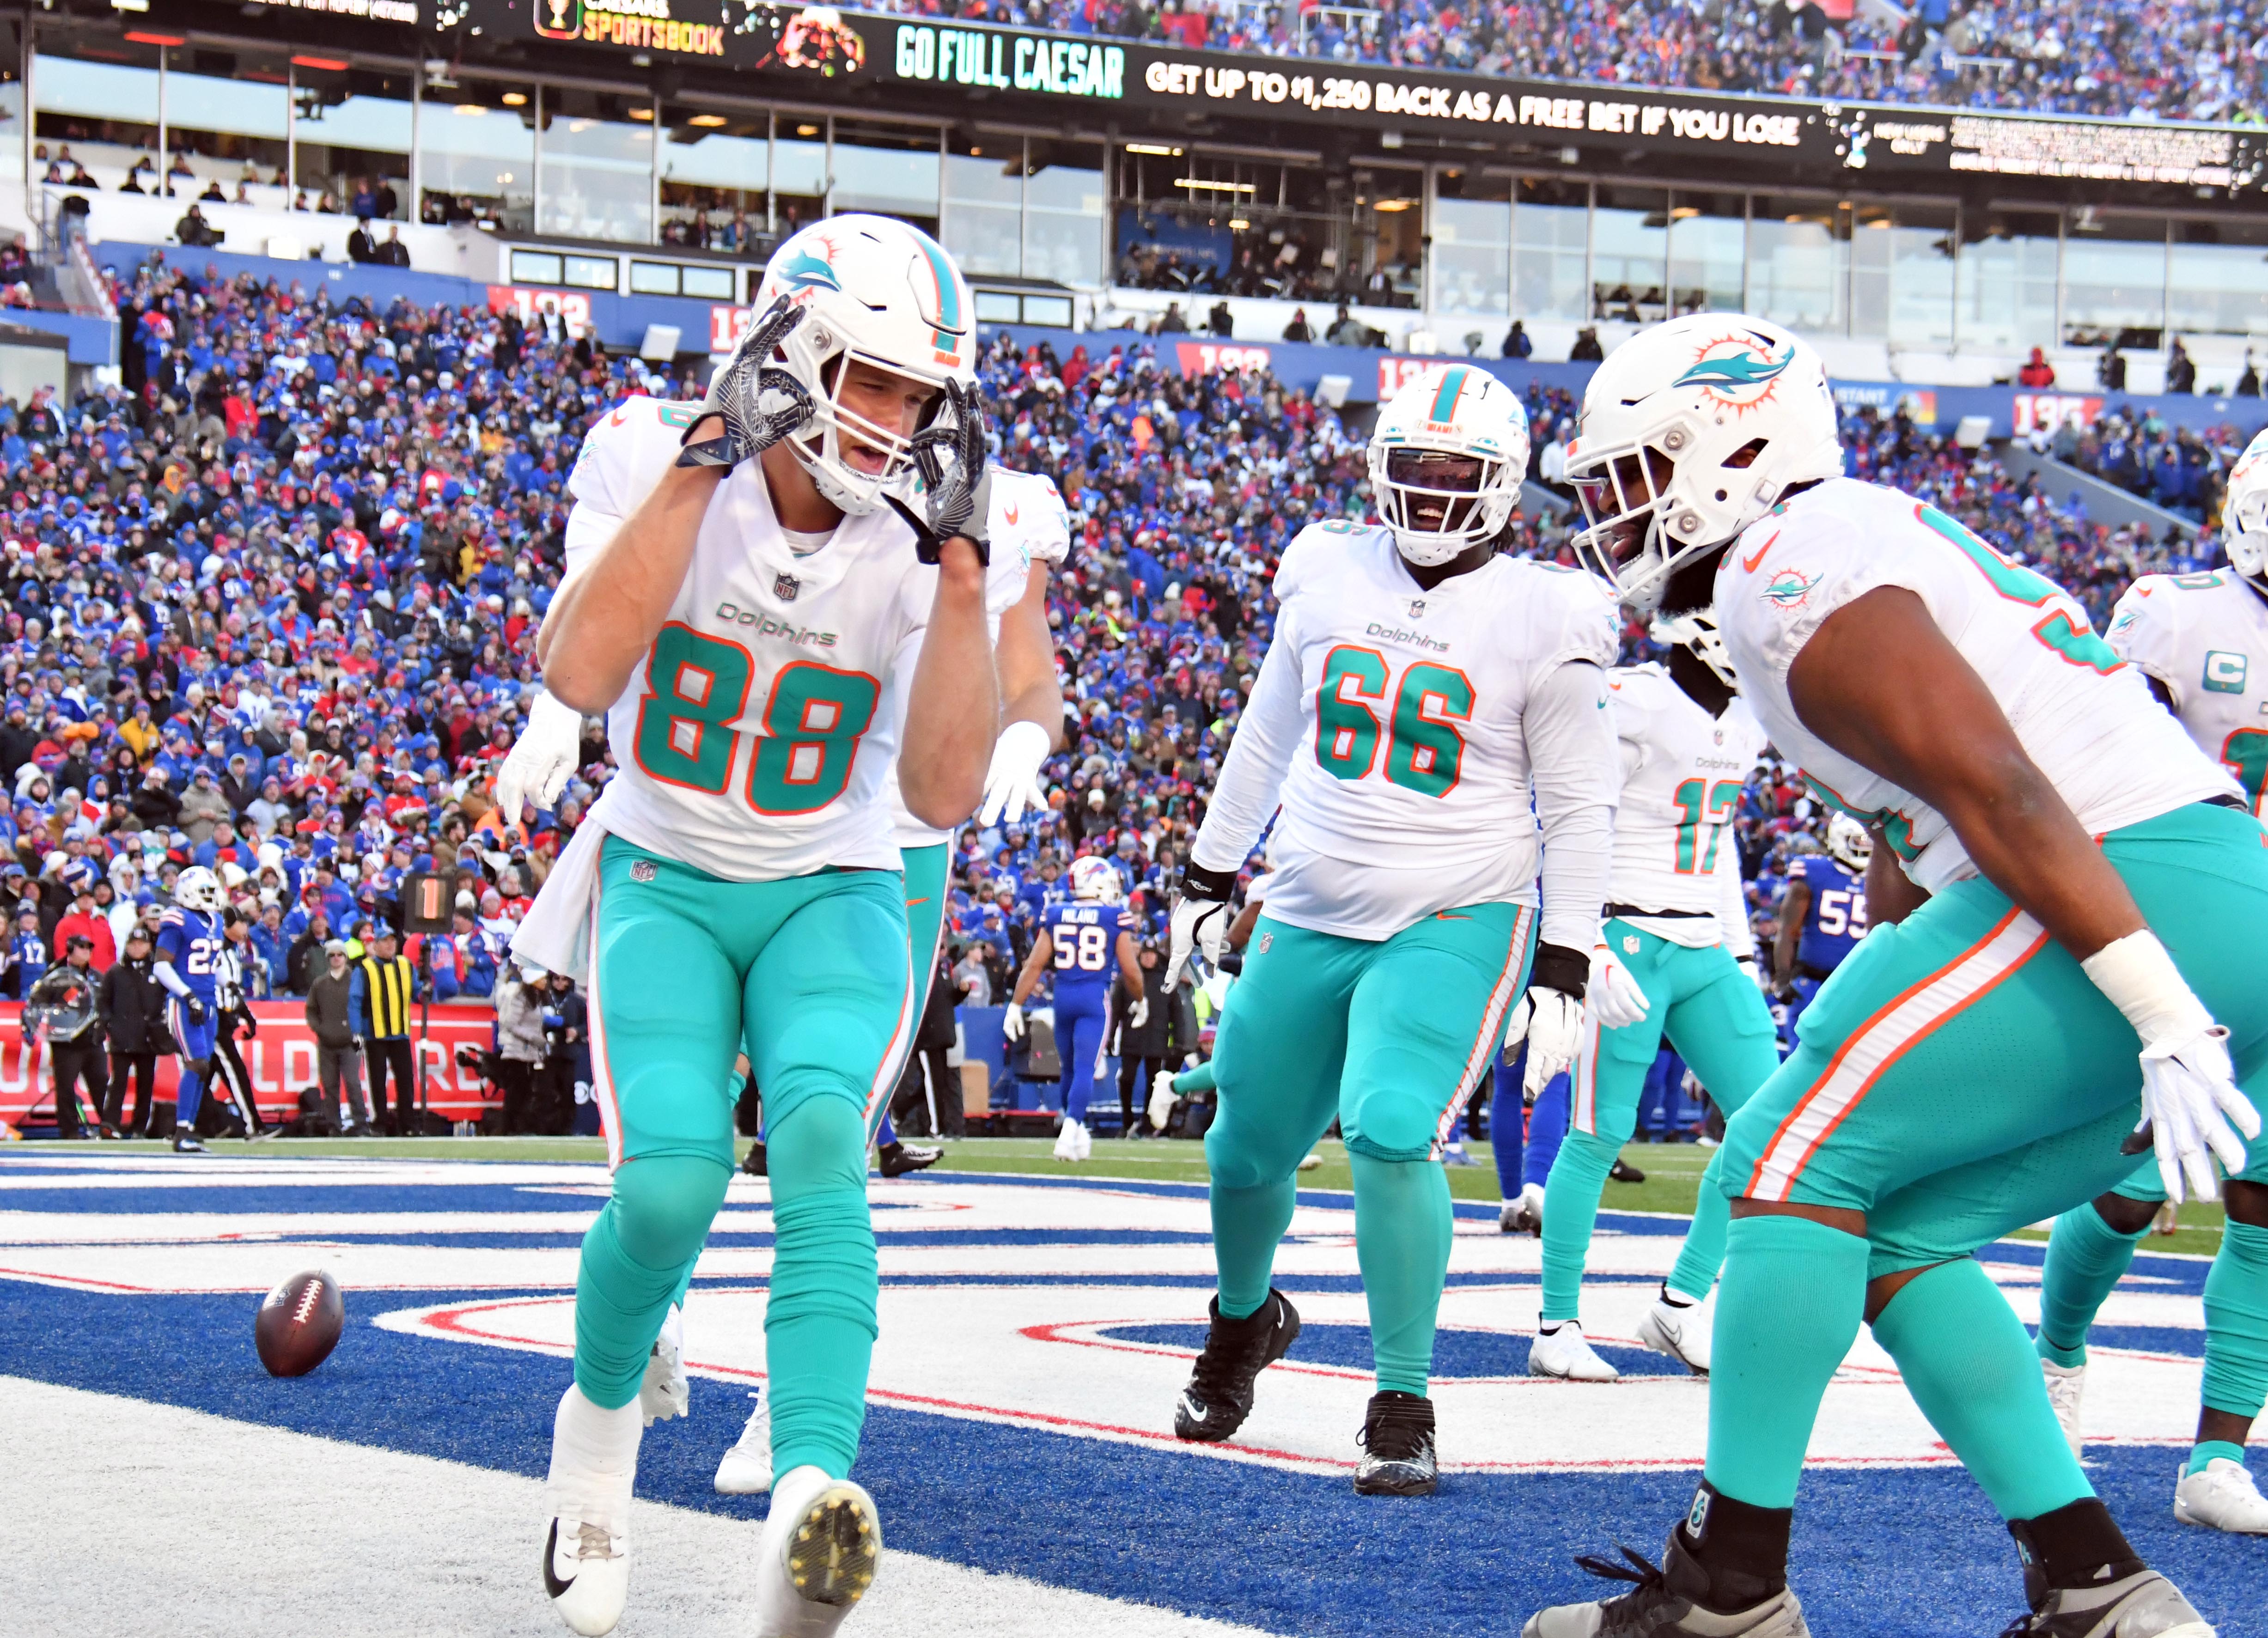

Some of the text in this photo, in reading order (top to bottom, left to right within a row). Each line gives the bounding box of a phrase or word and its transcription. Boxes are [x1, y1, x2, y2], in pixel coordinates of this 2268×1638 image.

[583, 10, 725, 56] SPORTSBOOK
[896, 25, 1125, 98] GO FULL CAESAR
[1146, 61, 1800, 146] GET UP TO $1,250 BACK AS A FREE BET IF YOU LOSE
[1427, 423, 1453, 434] MIAMI
[776, 583, 794, 598] NFL
[715, 603, 839, 648] Dolphins
[1366, 622, 1451, 653] Dolphins
[2207, 652, 2246, 684] C
[633, 620, 881, 816] 88
[1315, 644, 1476, 799] 66
[1695, 757, 1740, 772] Dolphins
[1674, 778, 1745, 874] 17
[633, 868, 652, 878] NFL
[421, 878, 439, 919] 1
[1061, 908, 1099, 924] MILANO
[1818, 889, 1869, 940] 55
[24, 942, 46, 964] 17
[1053, 924, 1108, 971] 58
